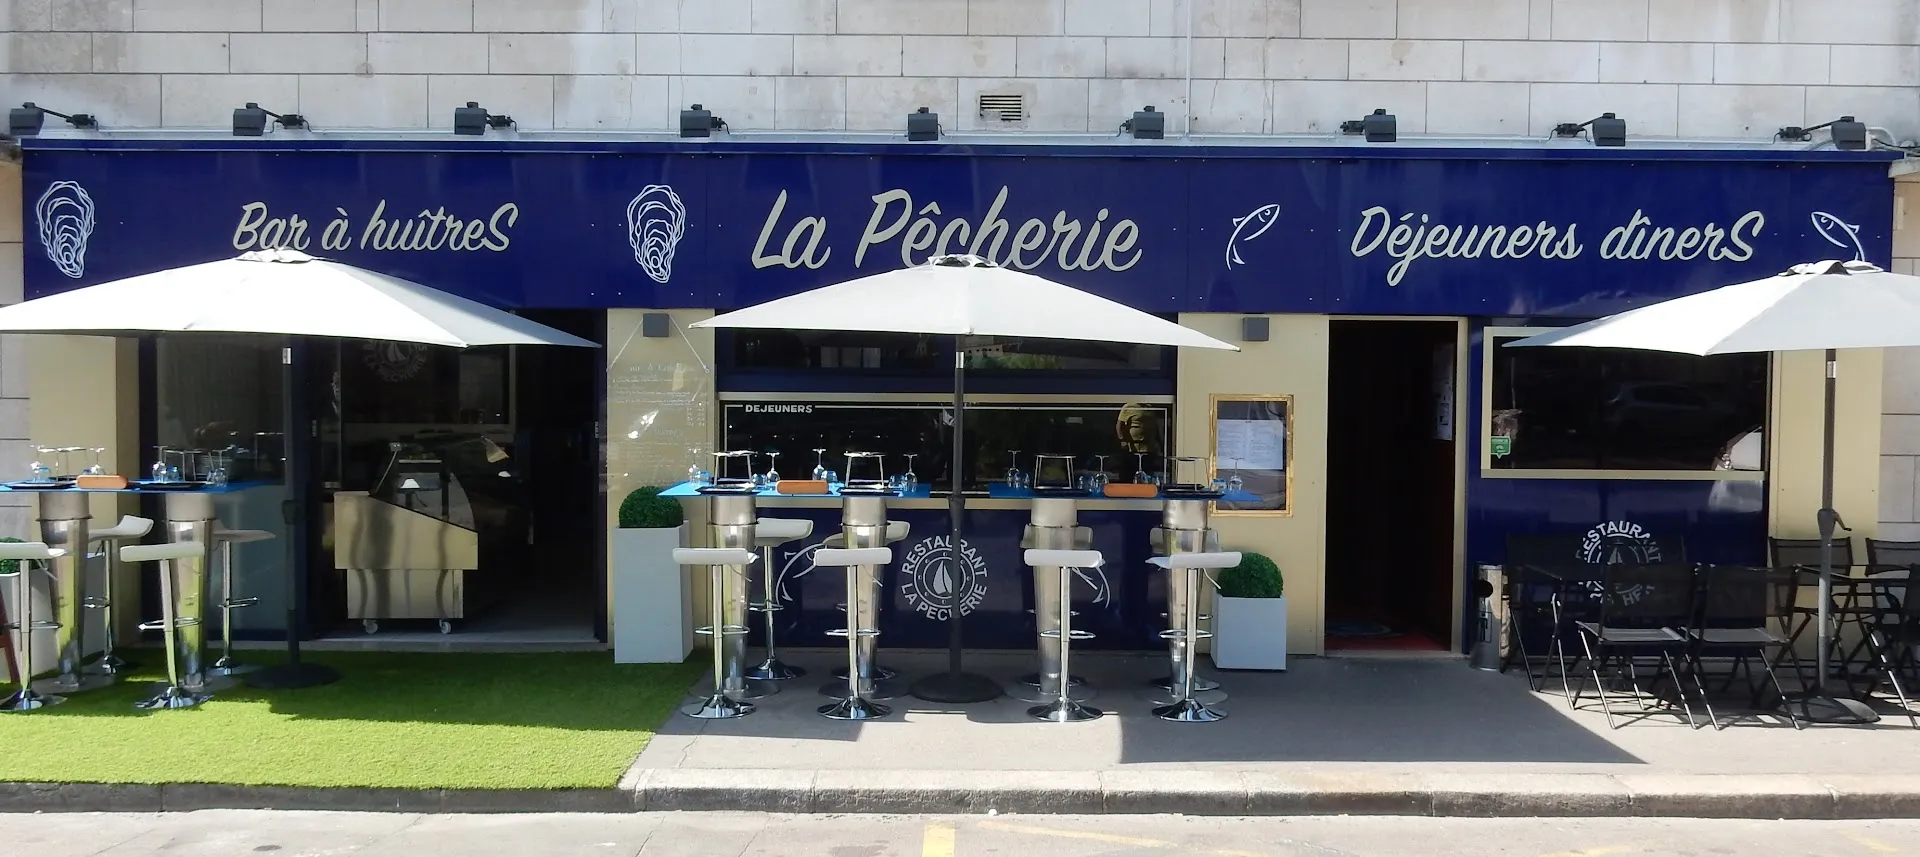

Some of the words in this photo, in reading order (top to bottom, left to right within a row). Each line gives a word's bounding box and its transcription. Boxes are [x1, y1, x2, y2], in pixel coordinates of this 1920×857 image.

[233, 202, 311, 250] Bar
[321, 206, 352, 251] à
[360, 199, 519, 252] huîtreS
[751, 189, 831, 270] La
[854, 185, 1143, 272] Pêcherie
[1350, 205, 1584, 287] Déjeuners
[745, 404, 813, 414] DEJEUNERS
[901, 583, 918, 605] LA
